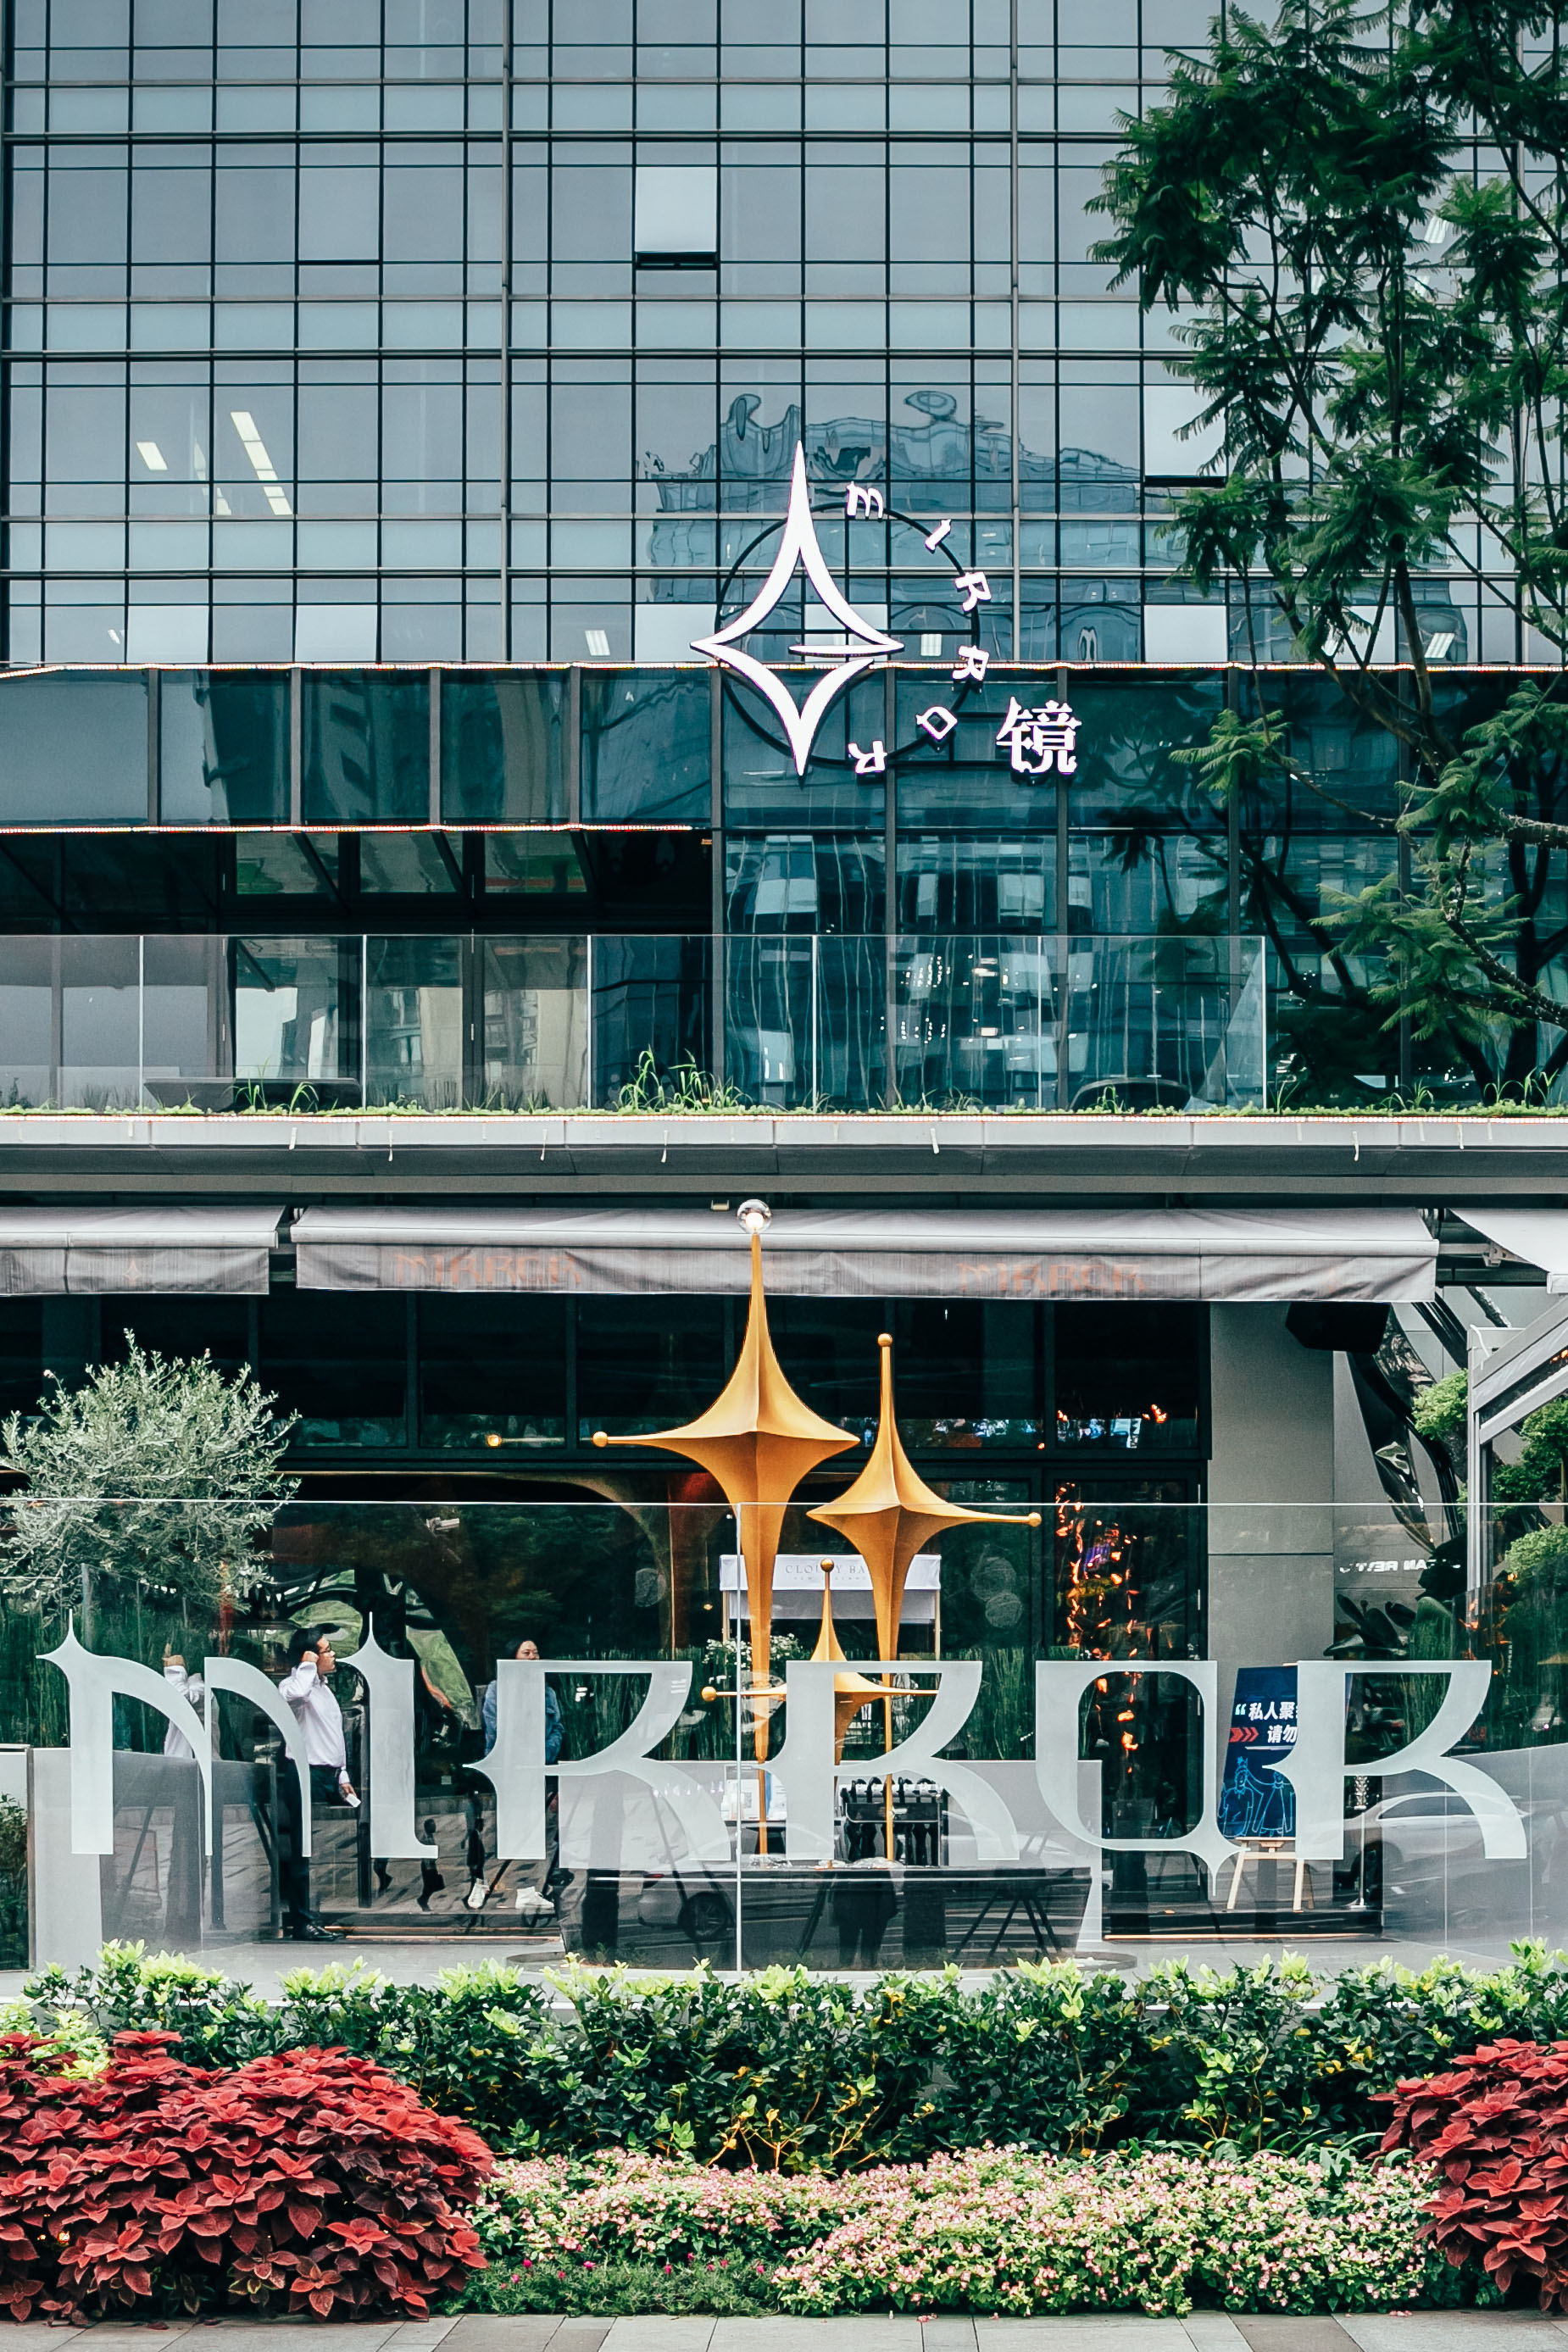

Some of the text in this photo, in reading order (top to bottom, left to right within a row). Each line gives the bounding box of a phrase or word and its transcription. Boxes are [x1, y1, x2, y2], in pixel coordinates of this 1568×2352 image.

[996, 696, 1082, 775] 镜
[393, 1253, 581, 1284] MIRROR
[956, 1262, 1145, 1293] MIRROR
[785, 1564, 843, 1574] CLOY
[1235, 1701, 1298, 1721] “私人聚
[36, 1609, 1527, 1897] MIRROR
